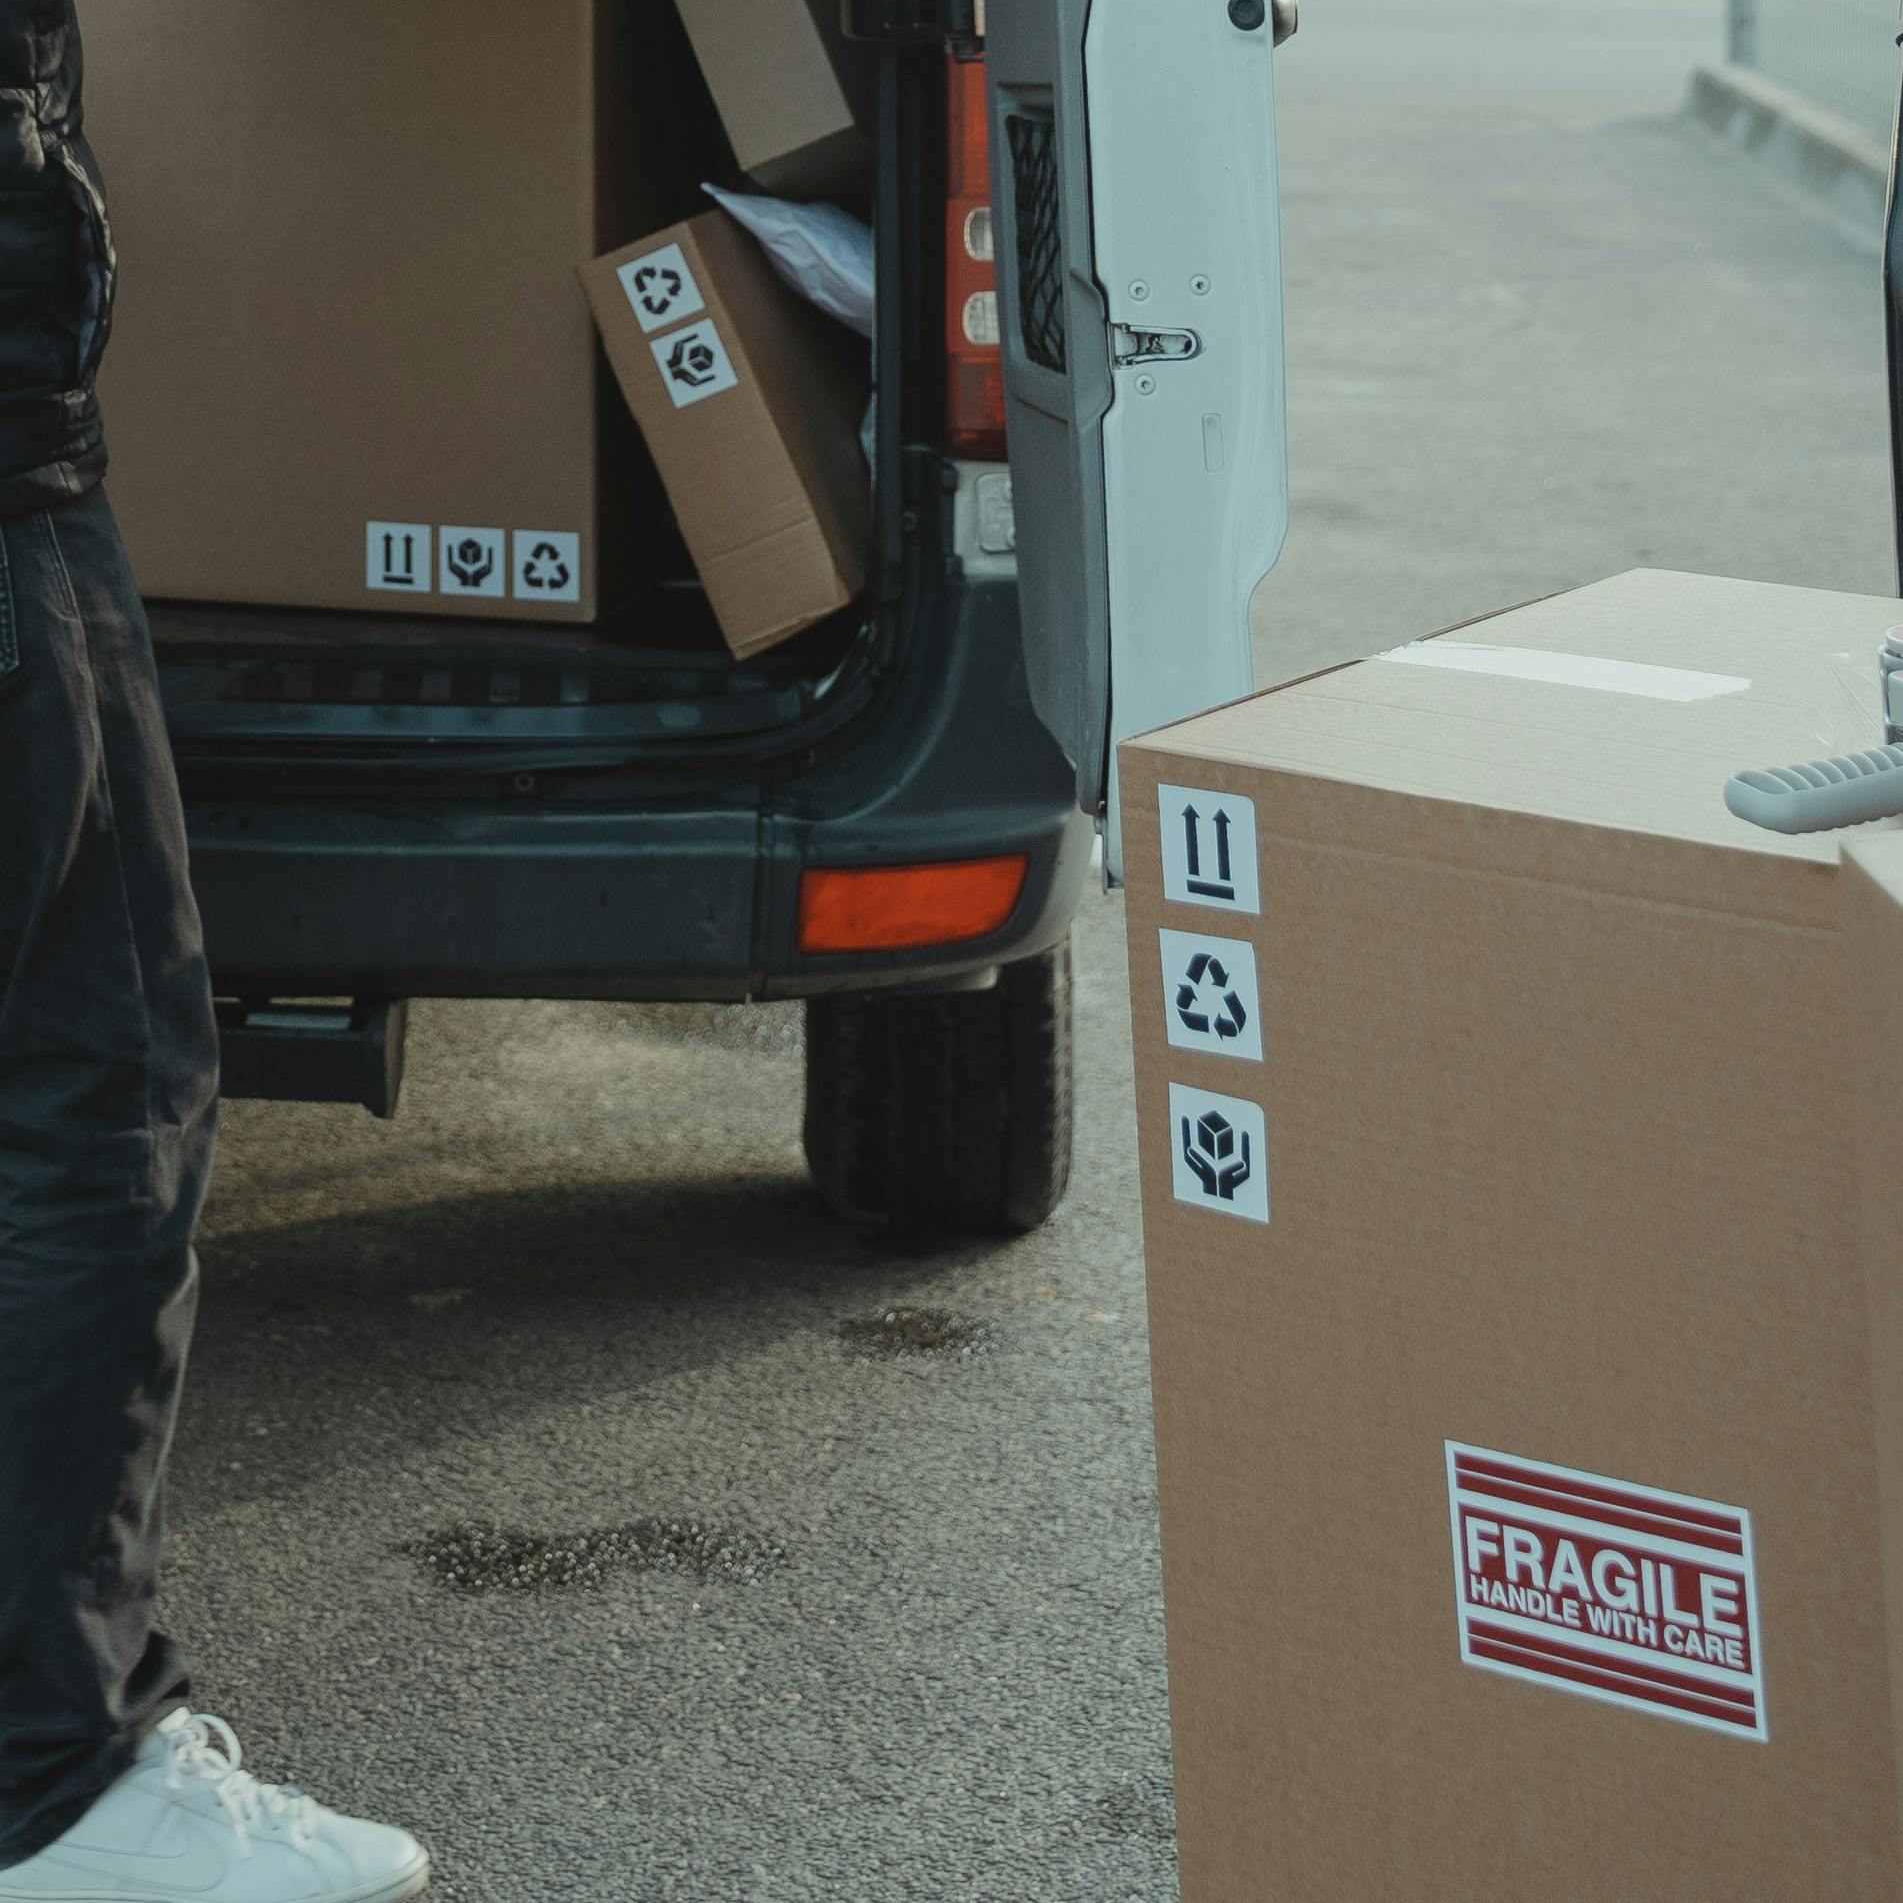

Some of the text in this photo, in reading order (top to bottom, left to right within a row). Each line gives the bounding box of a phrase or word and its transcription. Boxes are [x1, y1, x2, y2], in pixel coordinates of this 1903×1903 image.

[1465, 1516, 1743, 1638] FRAGILE
[1470, 1573, 1745, 1668] HANDLE WITH CARE
